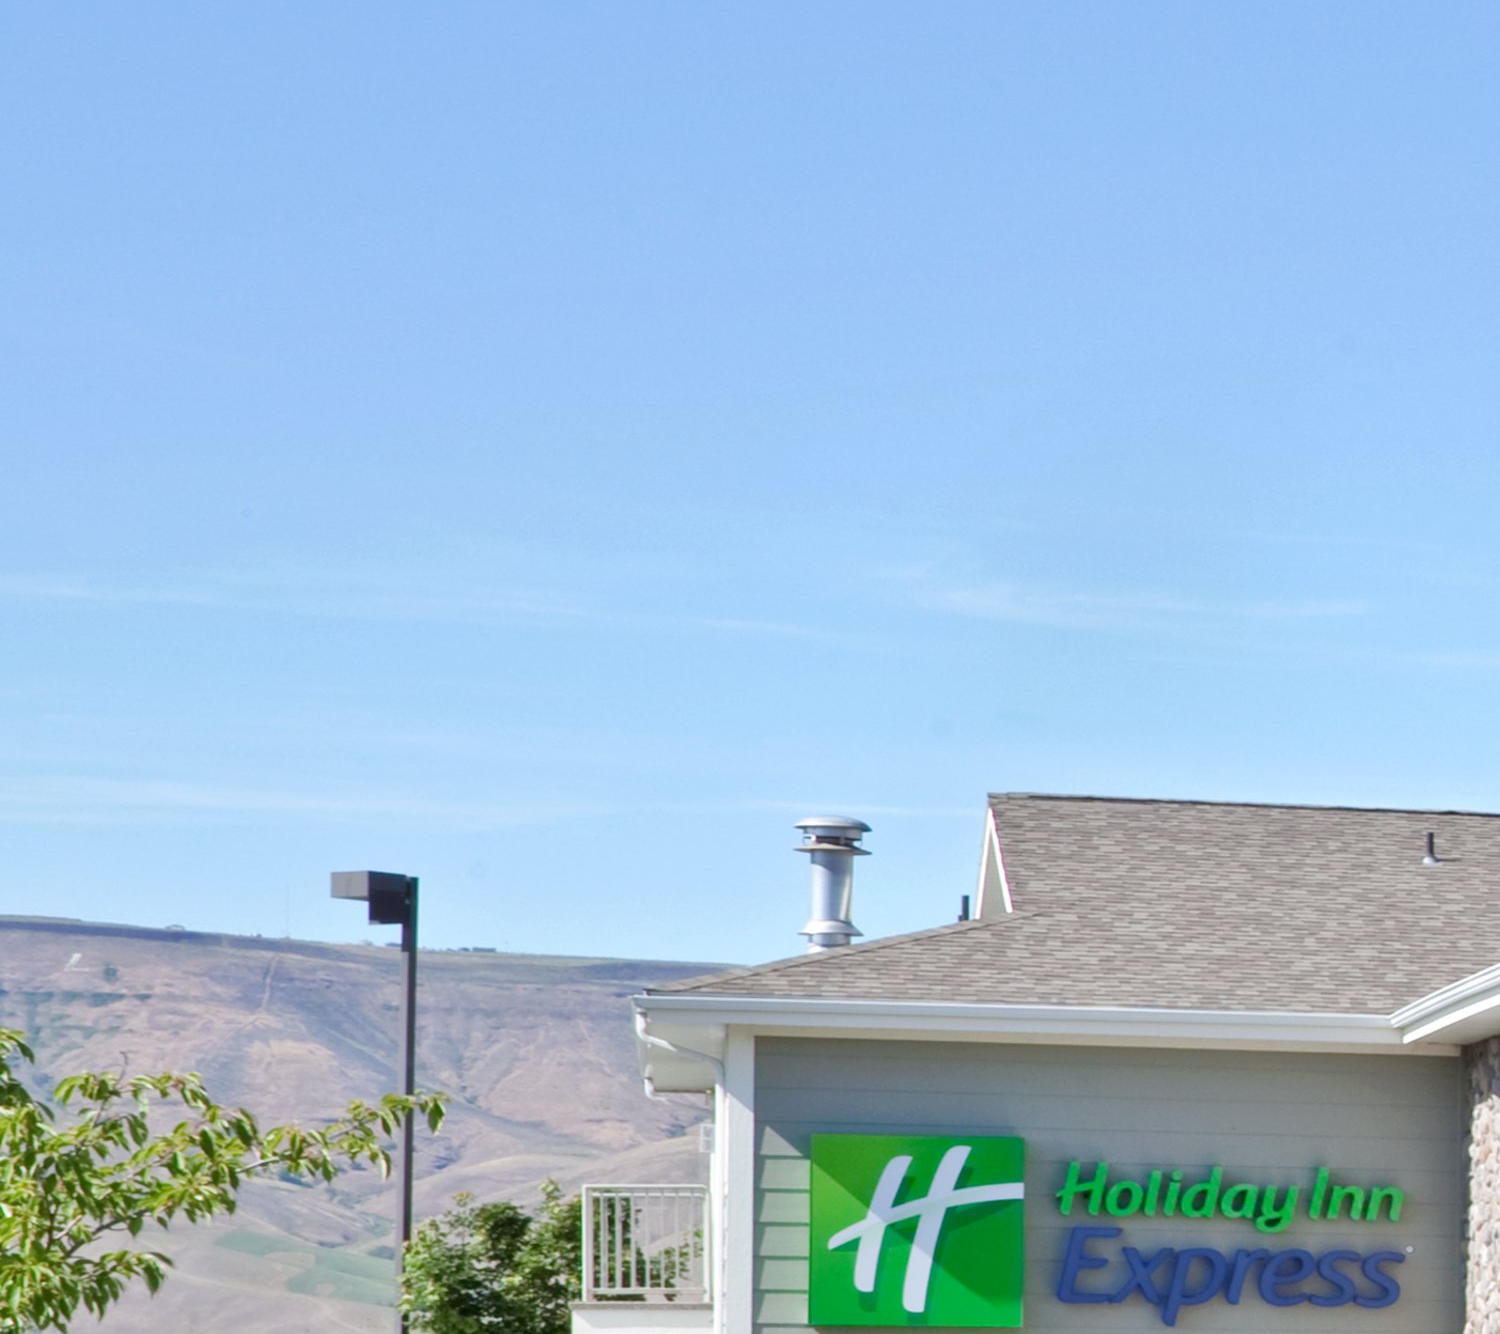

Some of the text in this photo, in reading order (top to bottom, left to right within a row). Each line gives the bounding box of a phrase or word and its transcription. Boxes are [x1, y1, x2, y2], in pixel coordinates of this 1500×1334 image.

[1056, 1161, 1405, 1233] Holiday Inn
[1056, 1226, 1406, 1327] Express
